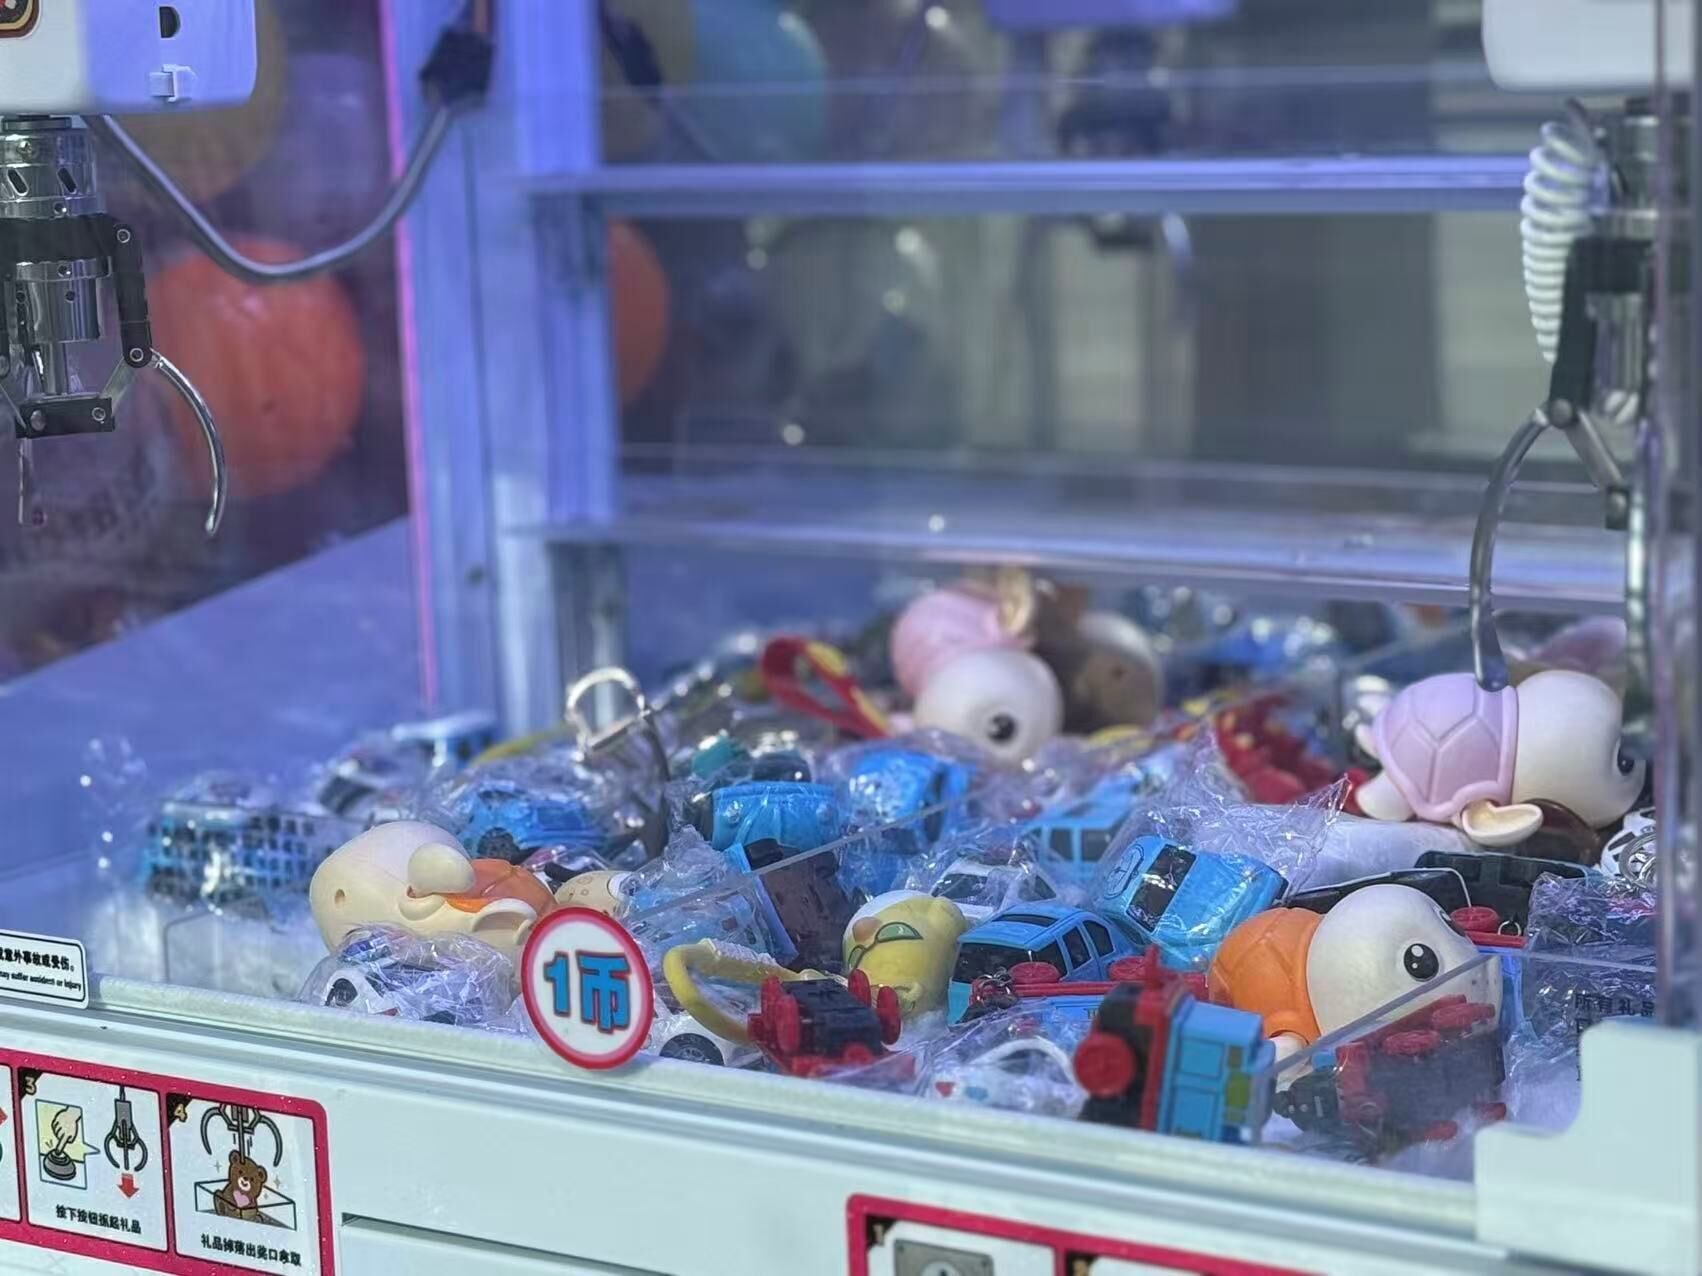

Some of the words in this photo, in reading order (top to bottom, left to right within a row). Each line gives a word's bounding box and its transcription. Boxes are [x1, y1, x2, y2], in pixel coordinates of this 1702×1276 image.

[543, 951, 631, 1034] 1币
[25, 1076, 36, 1094] 3
[175, 1104, 186, 1121] 4
[56, 1204, 142, 1234] 按下按钮抓起礼品
[201, 1233, 302, 1267] 礼品掉落出奖口拿取
